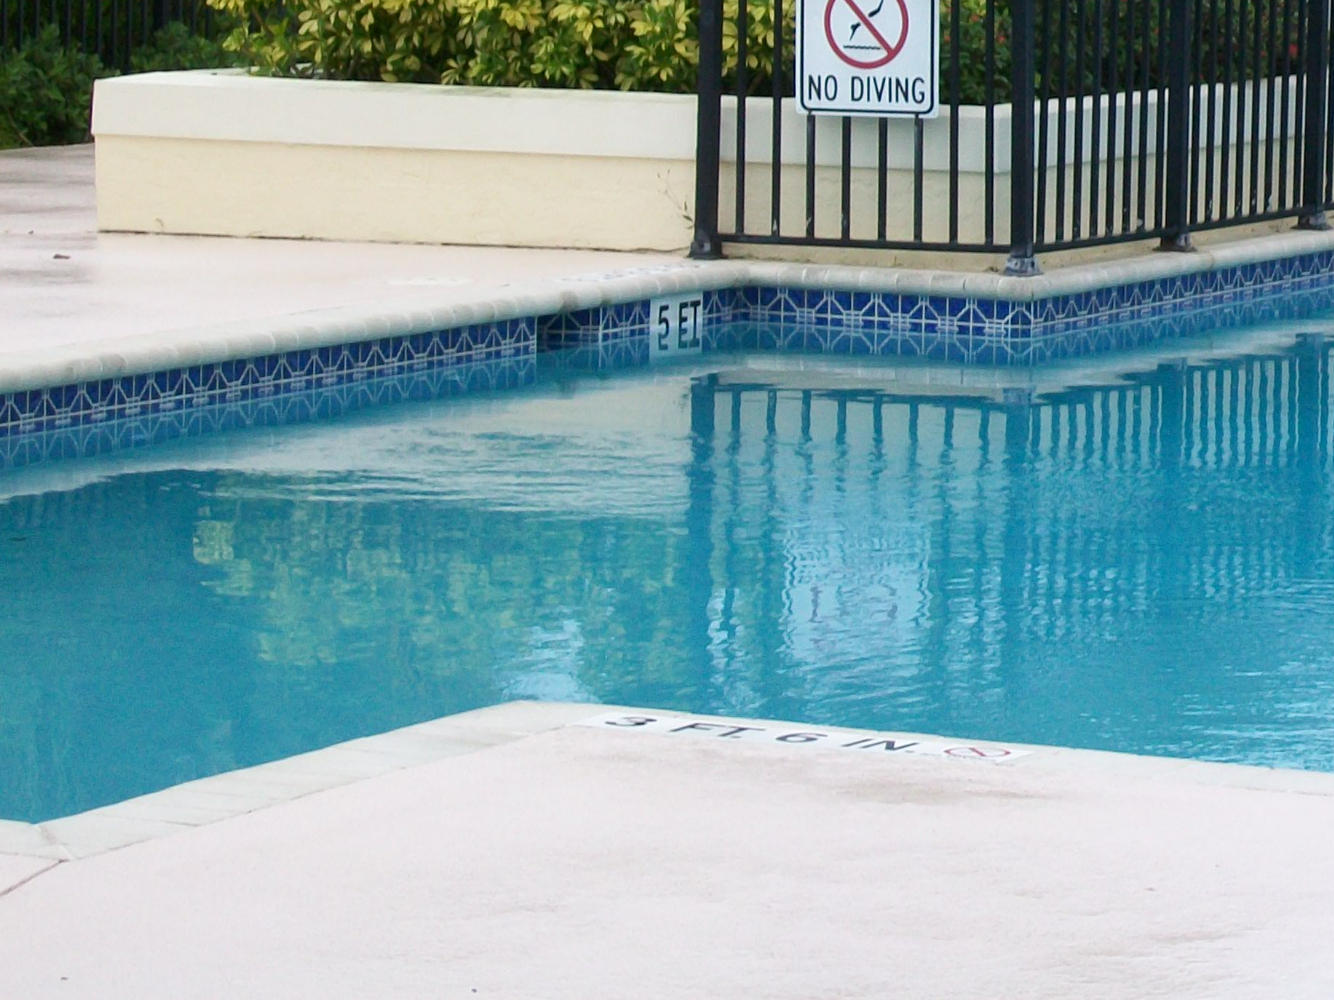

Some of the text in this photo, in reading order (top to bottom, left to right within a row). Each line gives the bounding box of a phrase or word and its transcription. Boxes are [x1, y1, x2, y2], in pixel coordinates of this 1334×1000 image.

[808, 74, 925, 104] NO DIVING
[605, 716, 657, 726] 3
[775, 732, 828, 743] 6
